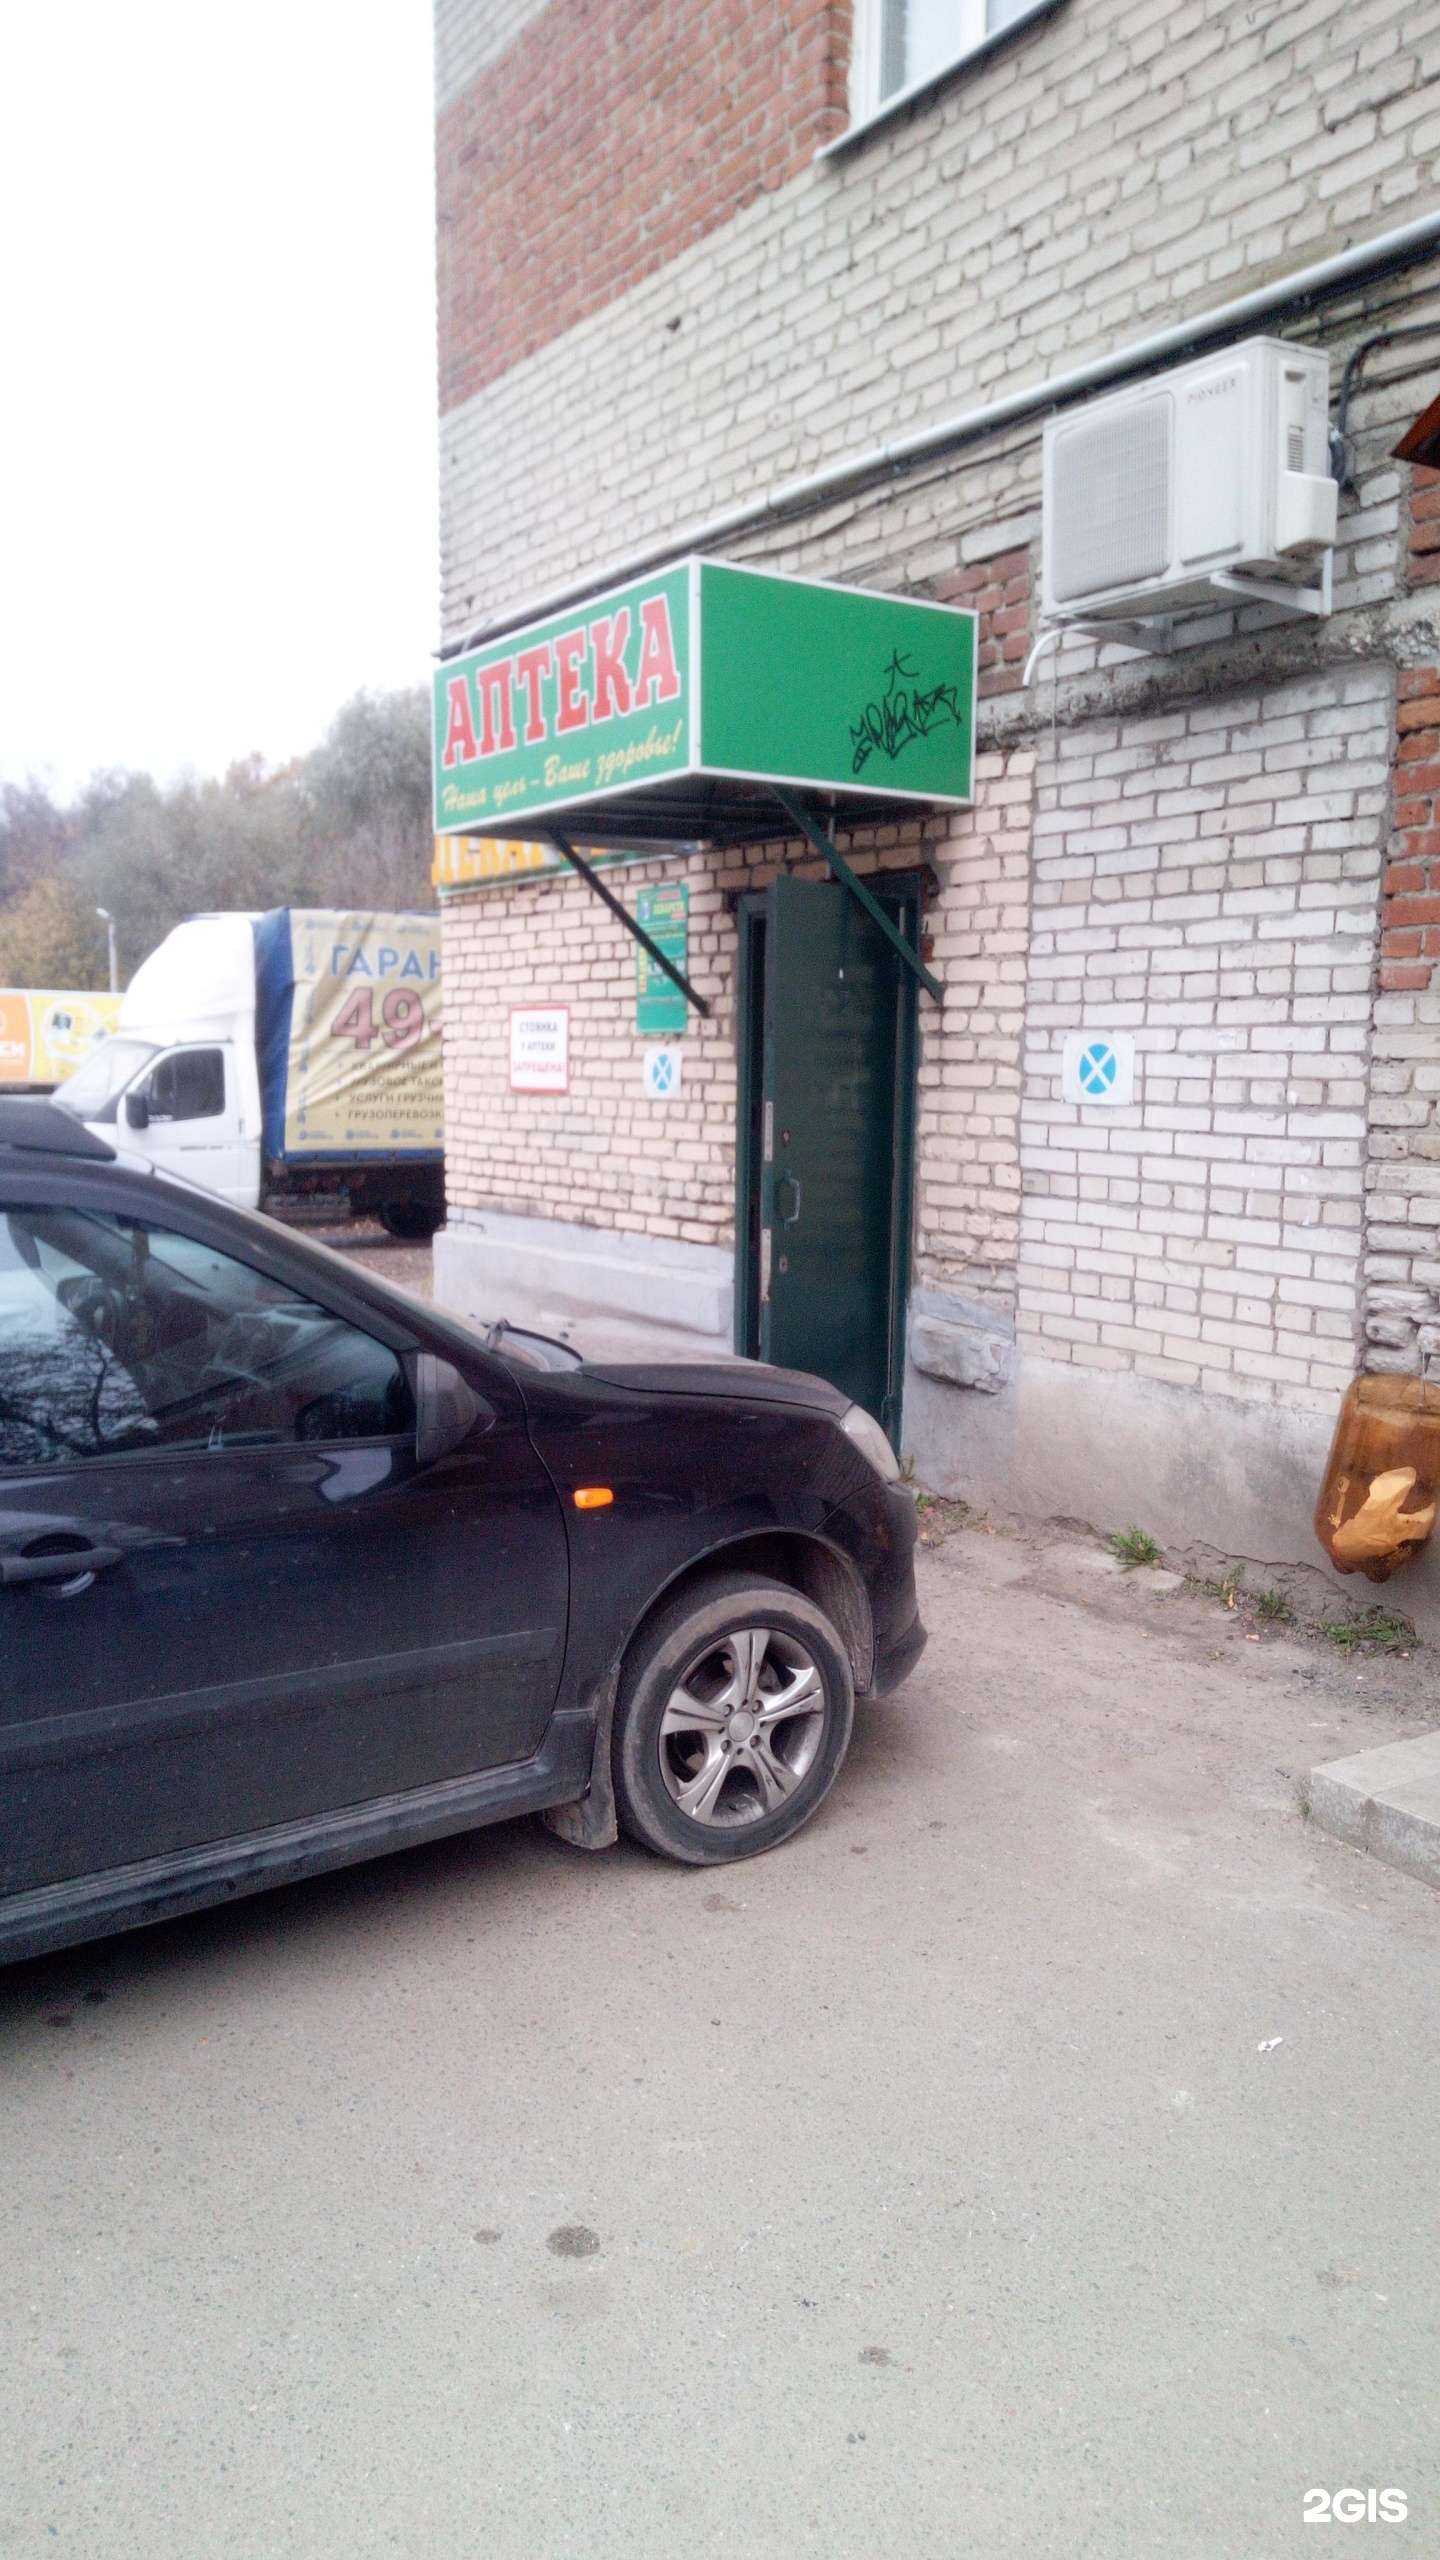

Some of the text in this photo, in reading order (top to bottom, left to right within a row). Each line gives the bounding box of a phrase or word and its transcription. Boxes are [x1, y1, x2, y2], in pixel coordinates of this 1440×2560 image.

[442, 593, 680, 770] АПТЕКА
[443, 782, 487, 811] Наша
[494, 777, 526, 806] цель
[544, 754, 591, 787] Ваше
[596, 719, 682, 786] здоровье!
